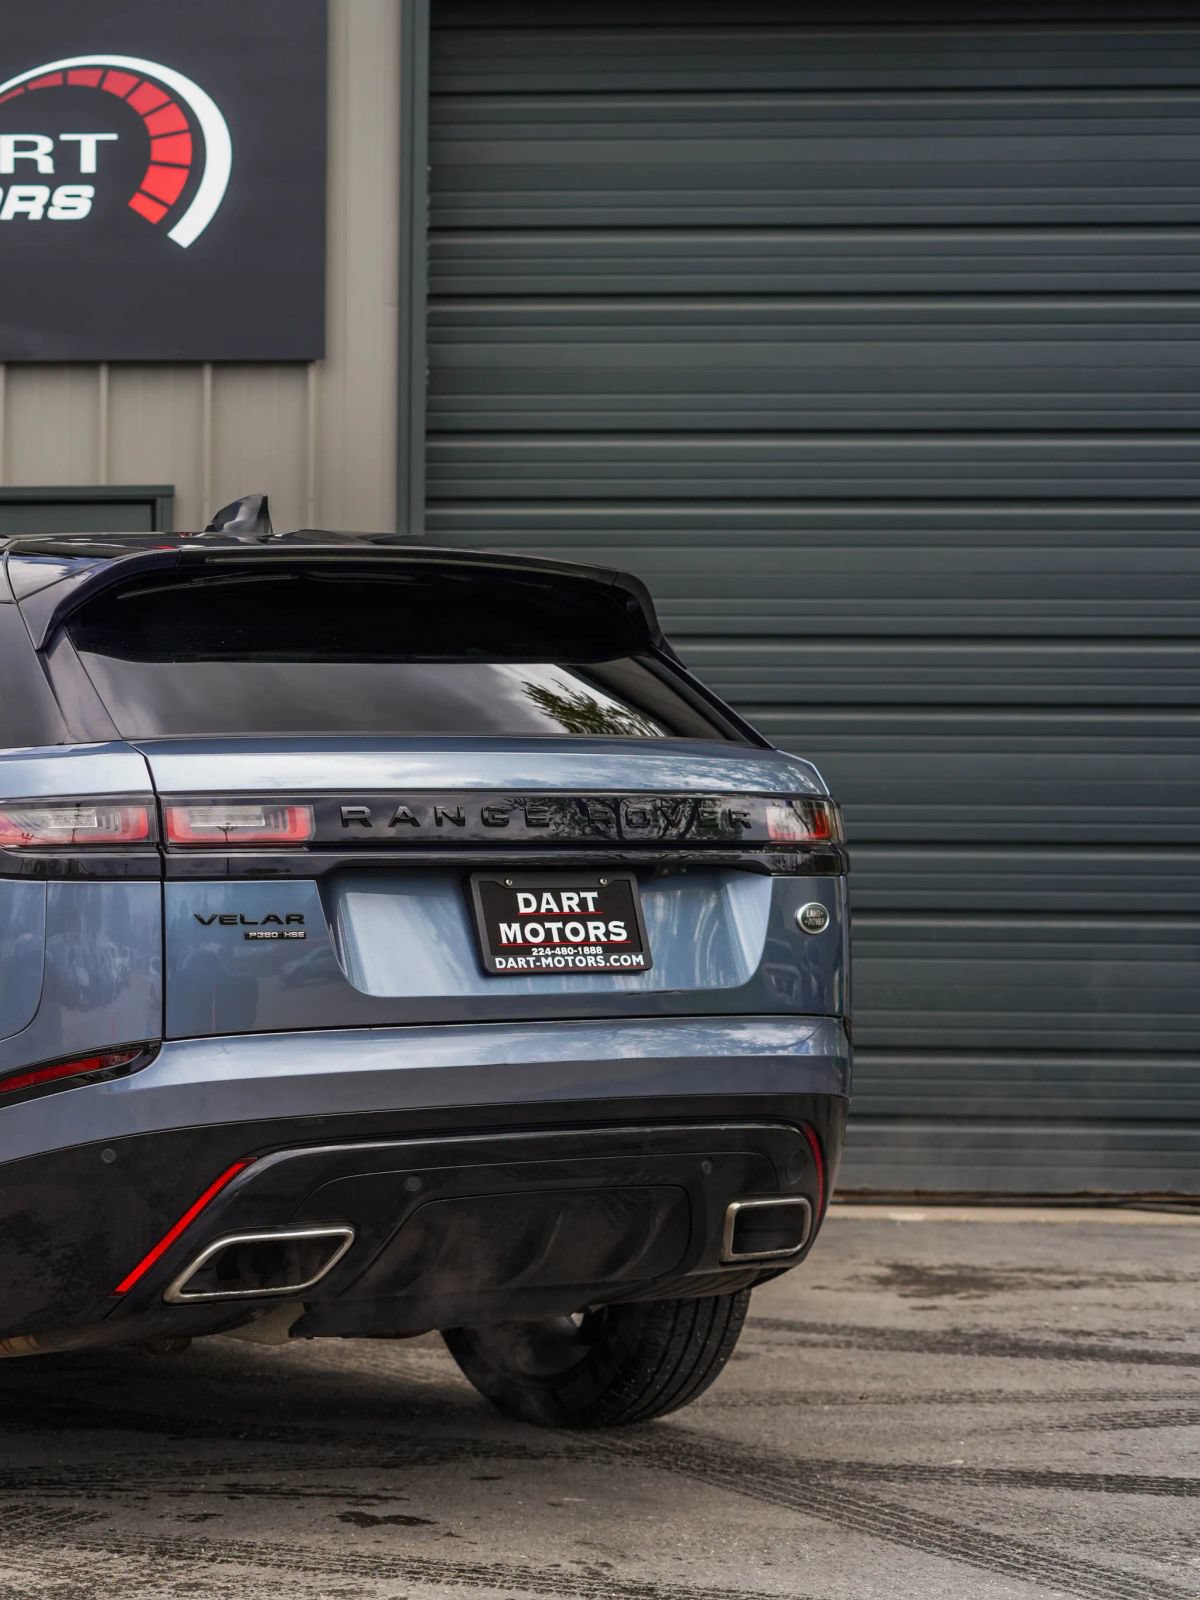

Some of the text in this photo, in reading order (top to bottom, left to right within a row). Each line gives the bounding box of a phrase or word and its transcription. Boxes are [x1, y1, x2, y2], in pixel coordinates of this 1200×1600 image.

[340, 805, 752, 829] RANGE ROVER
[516, 891, 599, 914] DART
[193, 913, 306, 926] VELAR
[248, 931, 280, 939] P380
[499, 920, 628, 944] MOTORS
[531, 946, 603, 956] 224-480-1888
[494, 954, 645, 969] DART-MOTORS.COM
